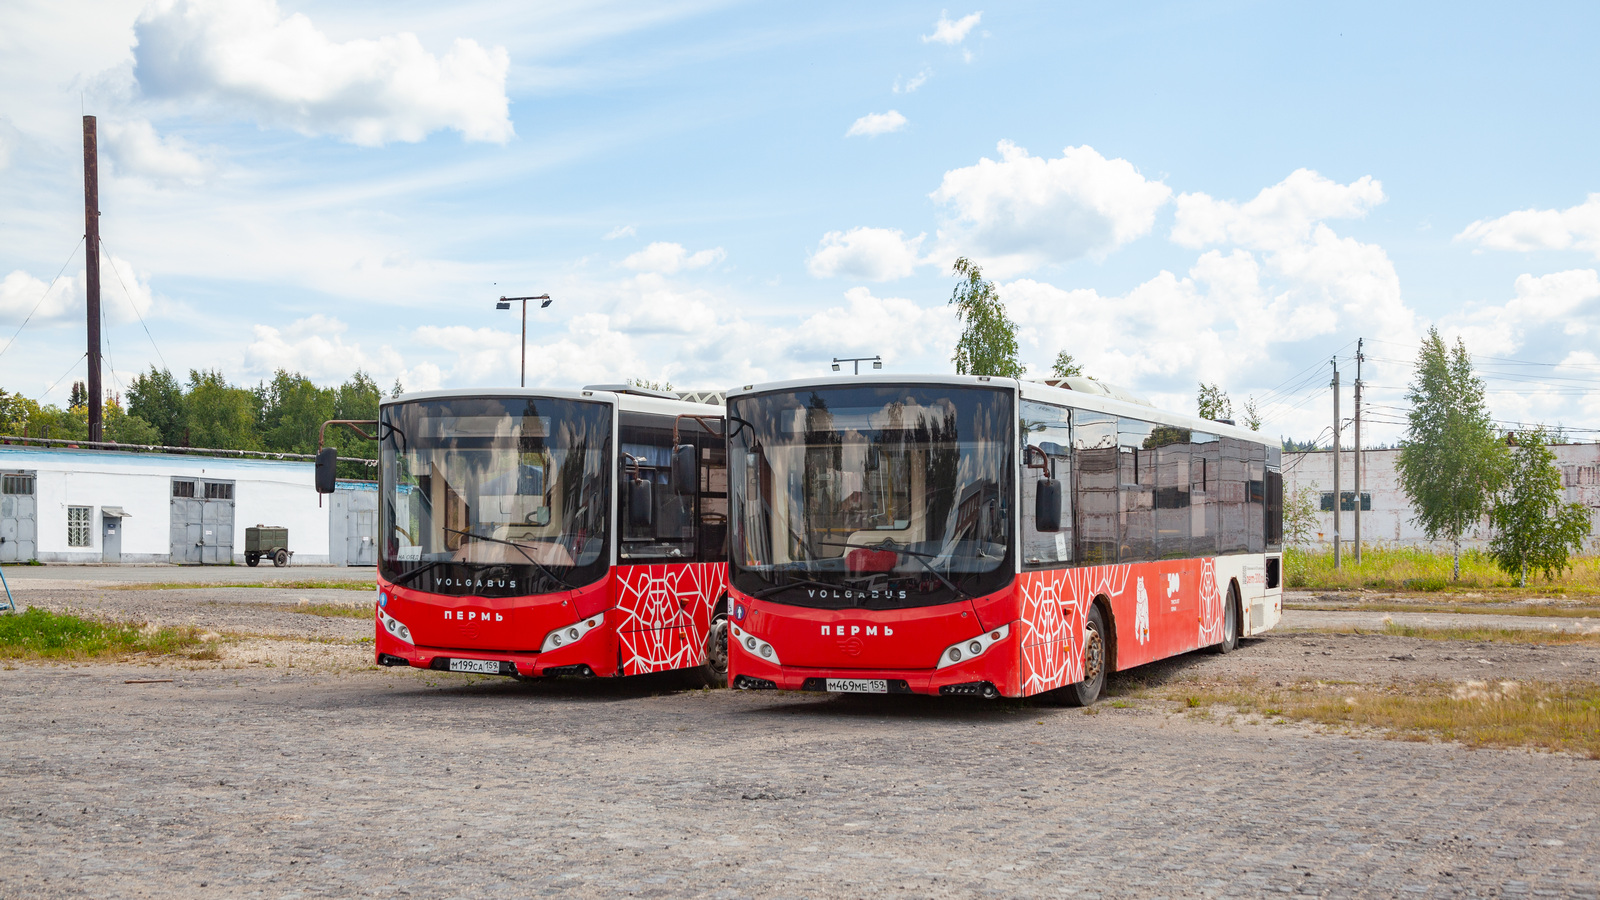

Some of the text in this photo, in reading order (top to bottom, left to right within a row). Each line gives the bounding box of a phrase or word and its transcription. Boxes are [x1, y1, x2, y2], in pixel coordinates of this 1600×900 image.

[436, 578, 516, 588] VOLGABUS
[808, 589, 907, 599] VOLGABUS
[444, 610, 504, 622] ПЕРМЬ
[821, 625, 894, 636] ПЕРМЬ
[485, 661, 498, 670] 159
[869, 680, 884, 689] 159
